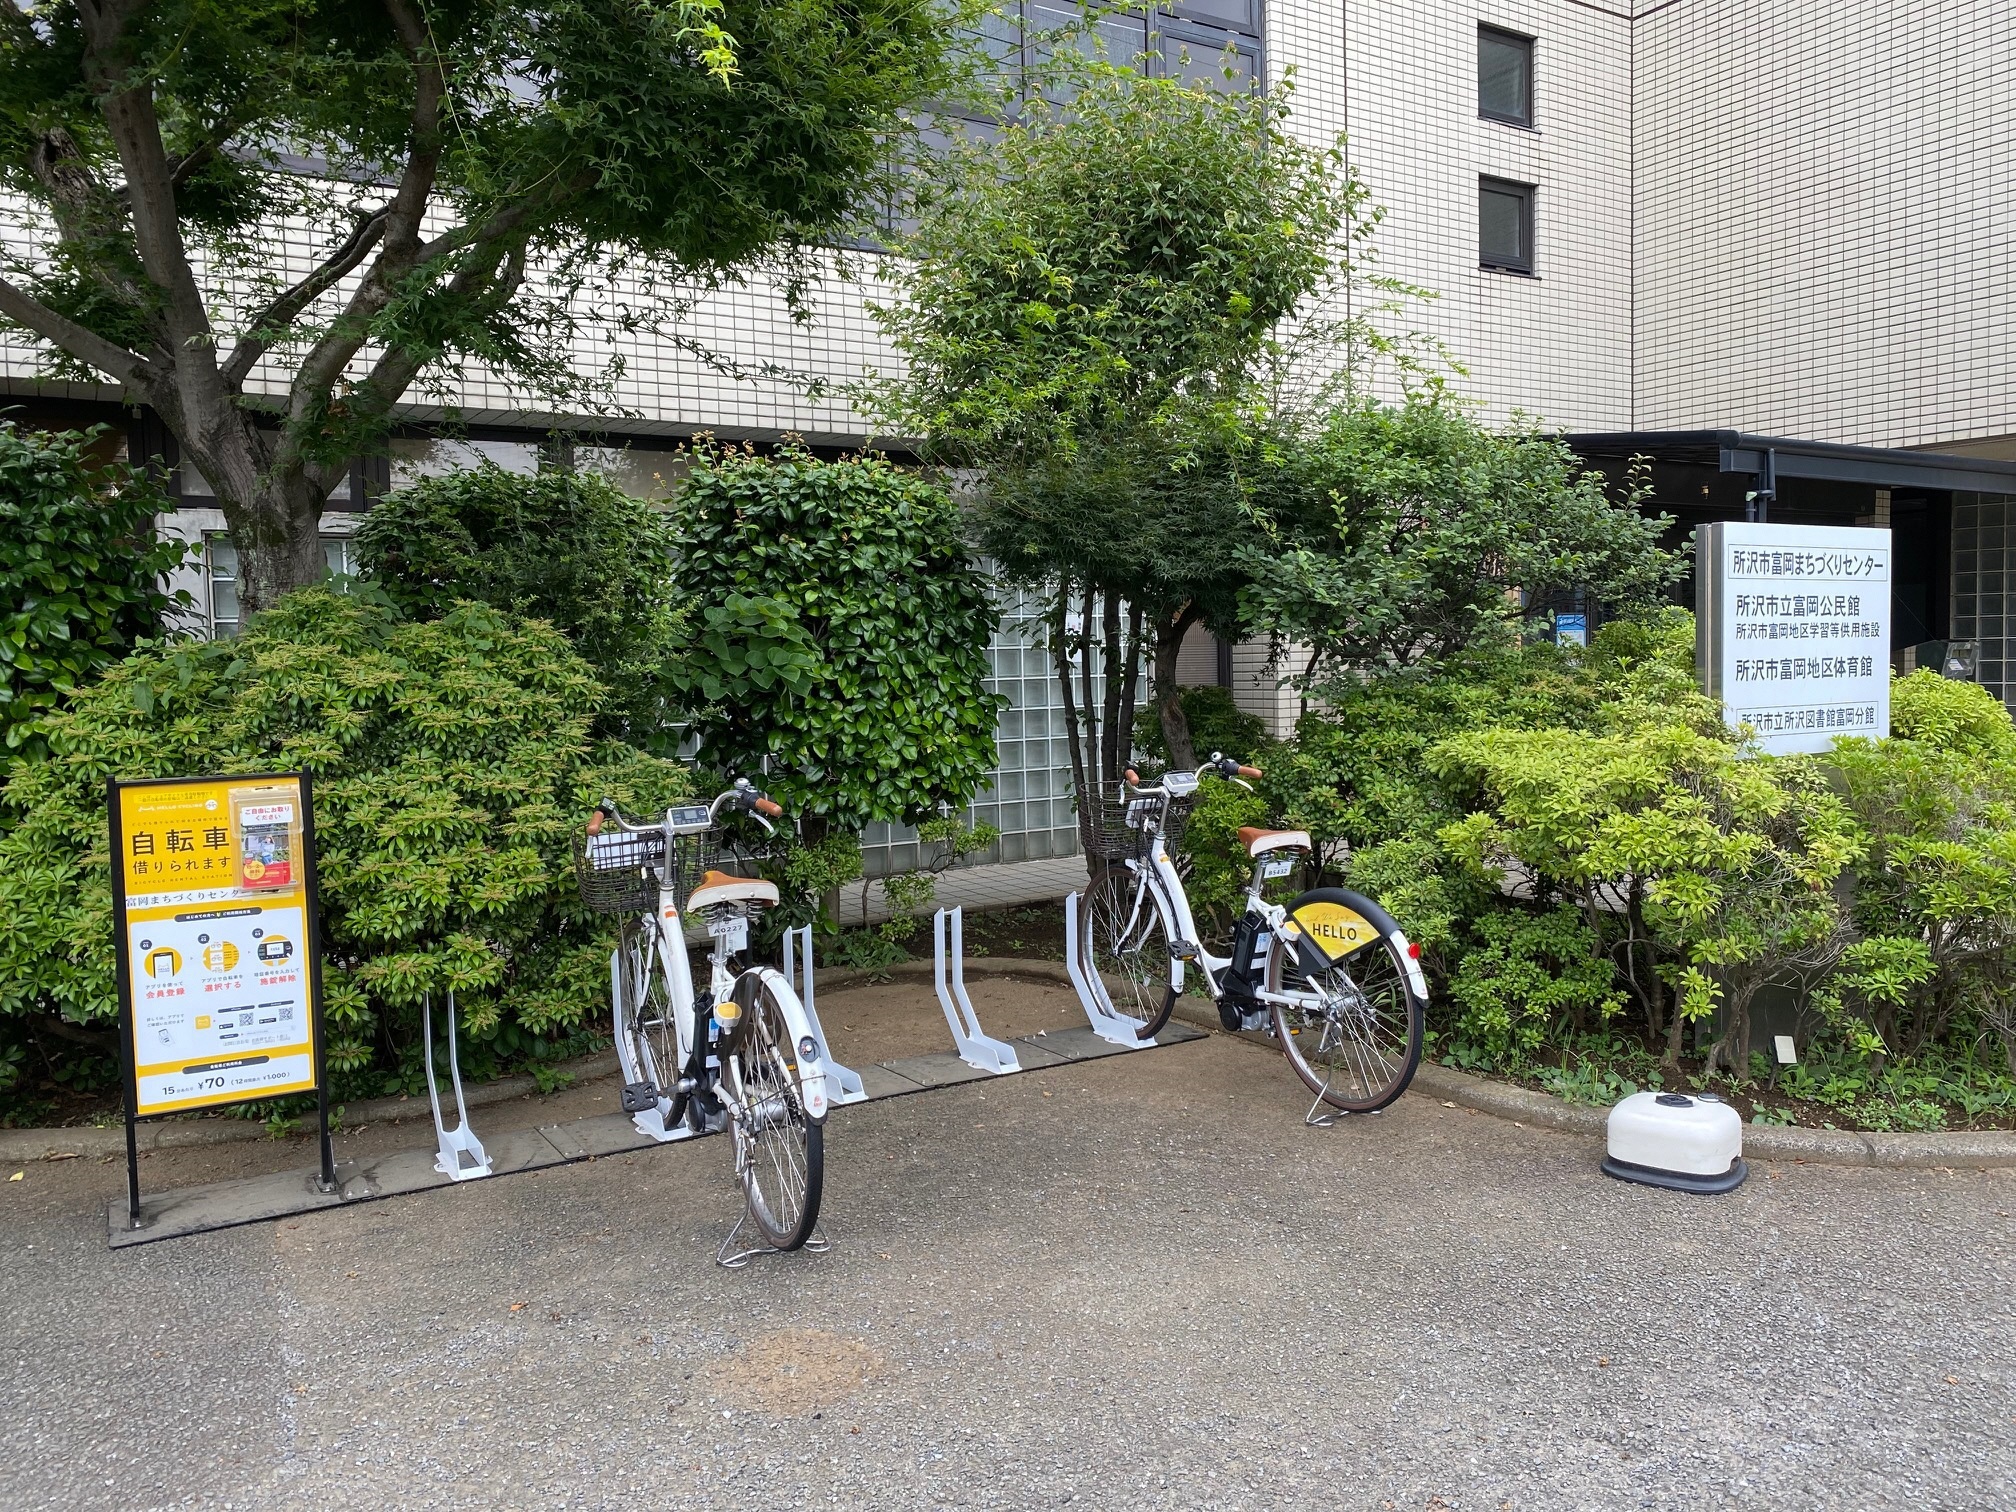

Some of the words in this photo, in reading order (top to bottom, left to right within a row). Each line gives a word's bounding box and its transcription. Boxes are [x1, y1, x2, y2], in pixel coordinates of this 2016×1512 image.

[1733, 550, 1884, 577] 所沢市富岡まちづくりセンター
[1735, 594, 1861, 617] 所沢市立富岡公民館
[1735, 622, 1881, 640] 所沢市富岡地区学習等供用施設
[1735, 655, 1873, 682] 所沢市富岡地区体育館
[244, 806, 290, 815] ご自由にお取り
[132, 826, 230, 857] 自転車
[132, 856, 232, 875] 借りられます
[134, 878, 166, 886] BICYCLE
[713, 925, 743, 934] A0227
[1312, 922, 1357, 941] HELLO
[145, 987, 186, 1000] 会員登録
[204, 981, 242, 993] 選択する
